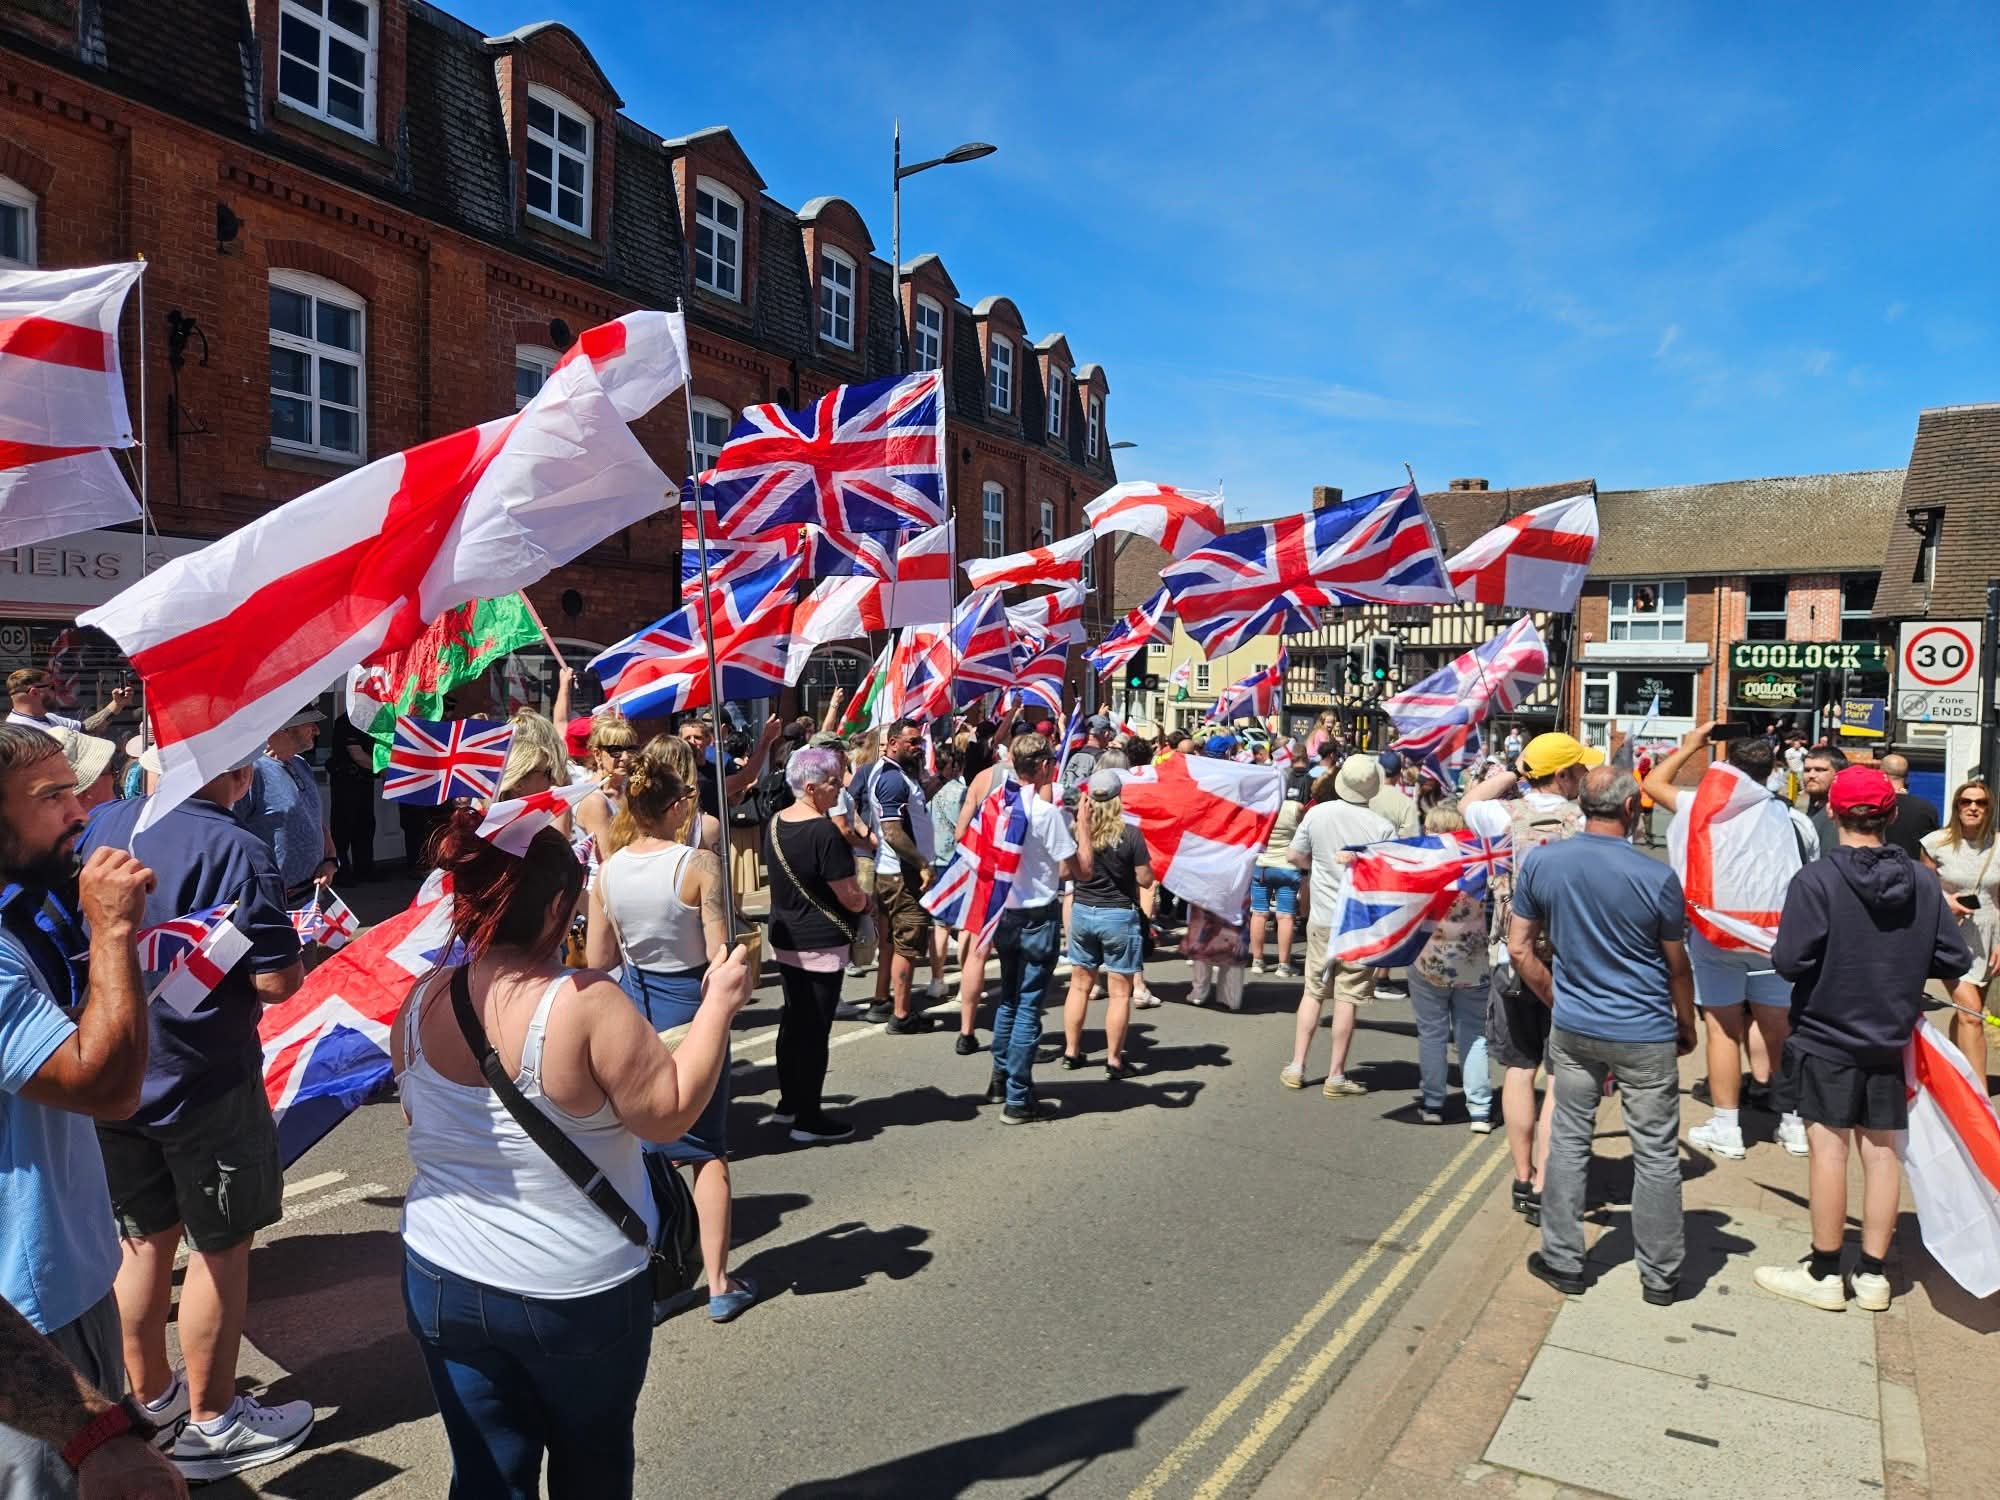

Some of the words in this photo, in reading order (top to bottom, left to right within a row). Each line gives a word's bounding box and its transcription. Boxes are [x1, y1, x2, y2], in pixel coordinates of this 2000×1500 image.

[1735, 644, 1861, 669] COOLOCK
[1917, 645, 1964, 667] 30
[1745, 682, 1797, 698] COOLOCK
[1938, 696, 1964, 704] Zone
[1845, 701, 1873, 712] Roger
[1932, 707, 1973, 717] ENDS
[1845, 710, 1870, 721] Parry
